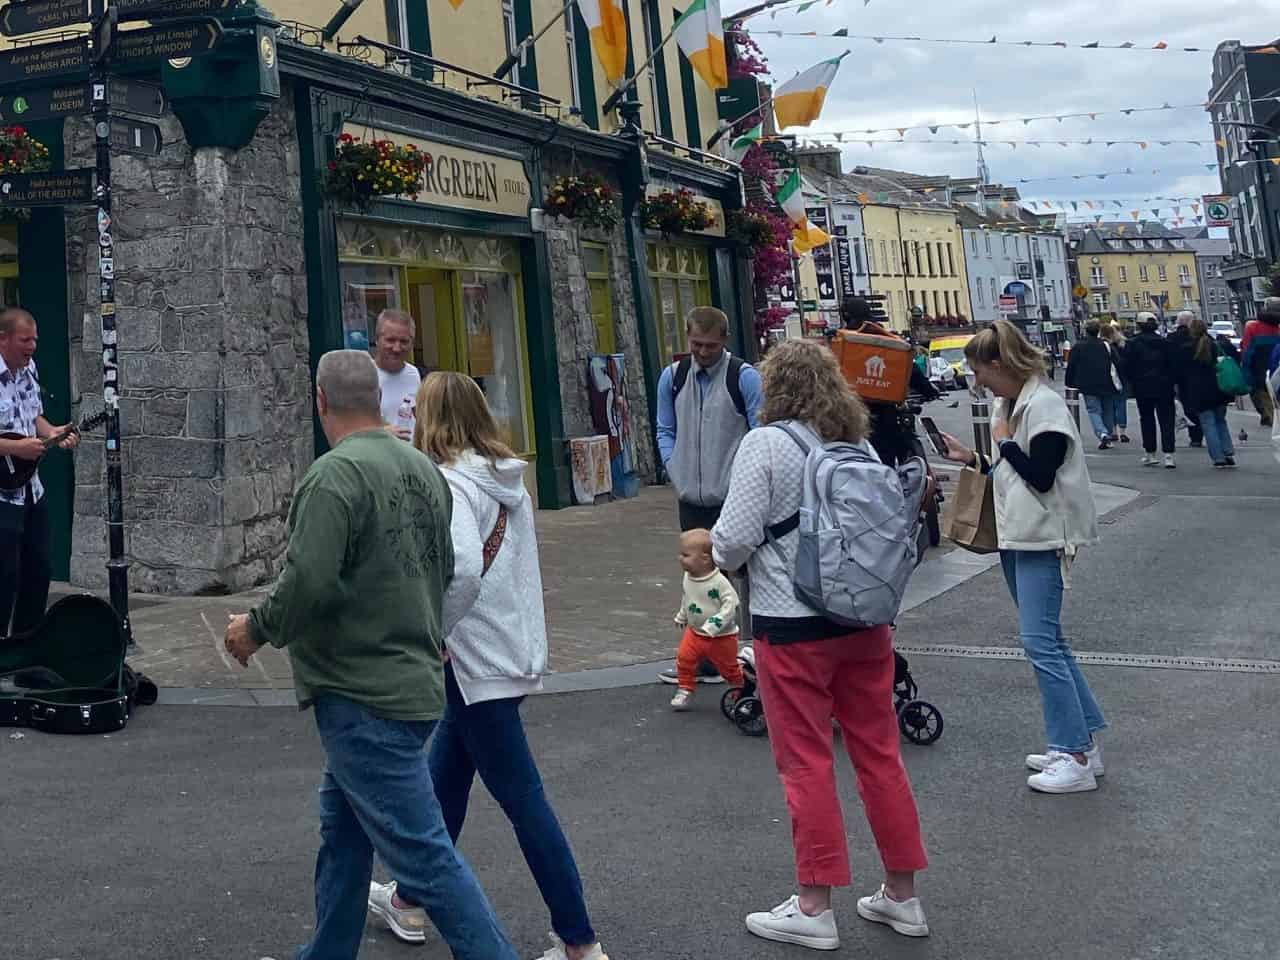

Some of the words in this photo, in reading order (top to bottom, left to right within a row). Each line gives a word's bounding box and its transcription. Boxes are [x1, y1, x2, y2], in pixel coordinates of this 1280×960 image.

[154, 42, 191, 54] WINDOW
[25, 61, 60, 74] SPANISH
[60, 56, 84, 68] ARCH
[50, 99, 83, 111] MUSEUM
[419, 153, 497, 203] RGREEN
[504, 178, 527, 196] STORE
[856, 376, 875, 386] JUST
[876, 379, 891, 388] EAT
